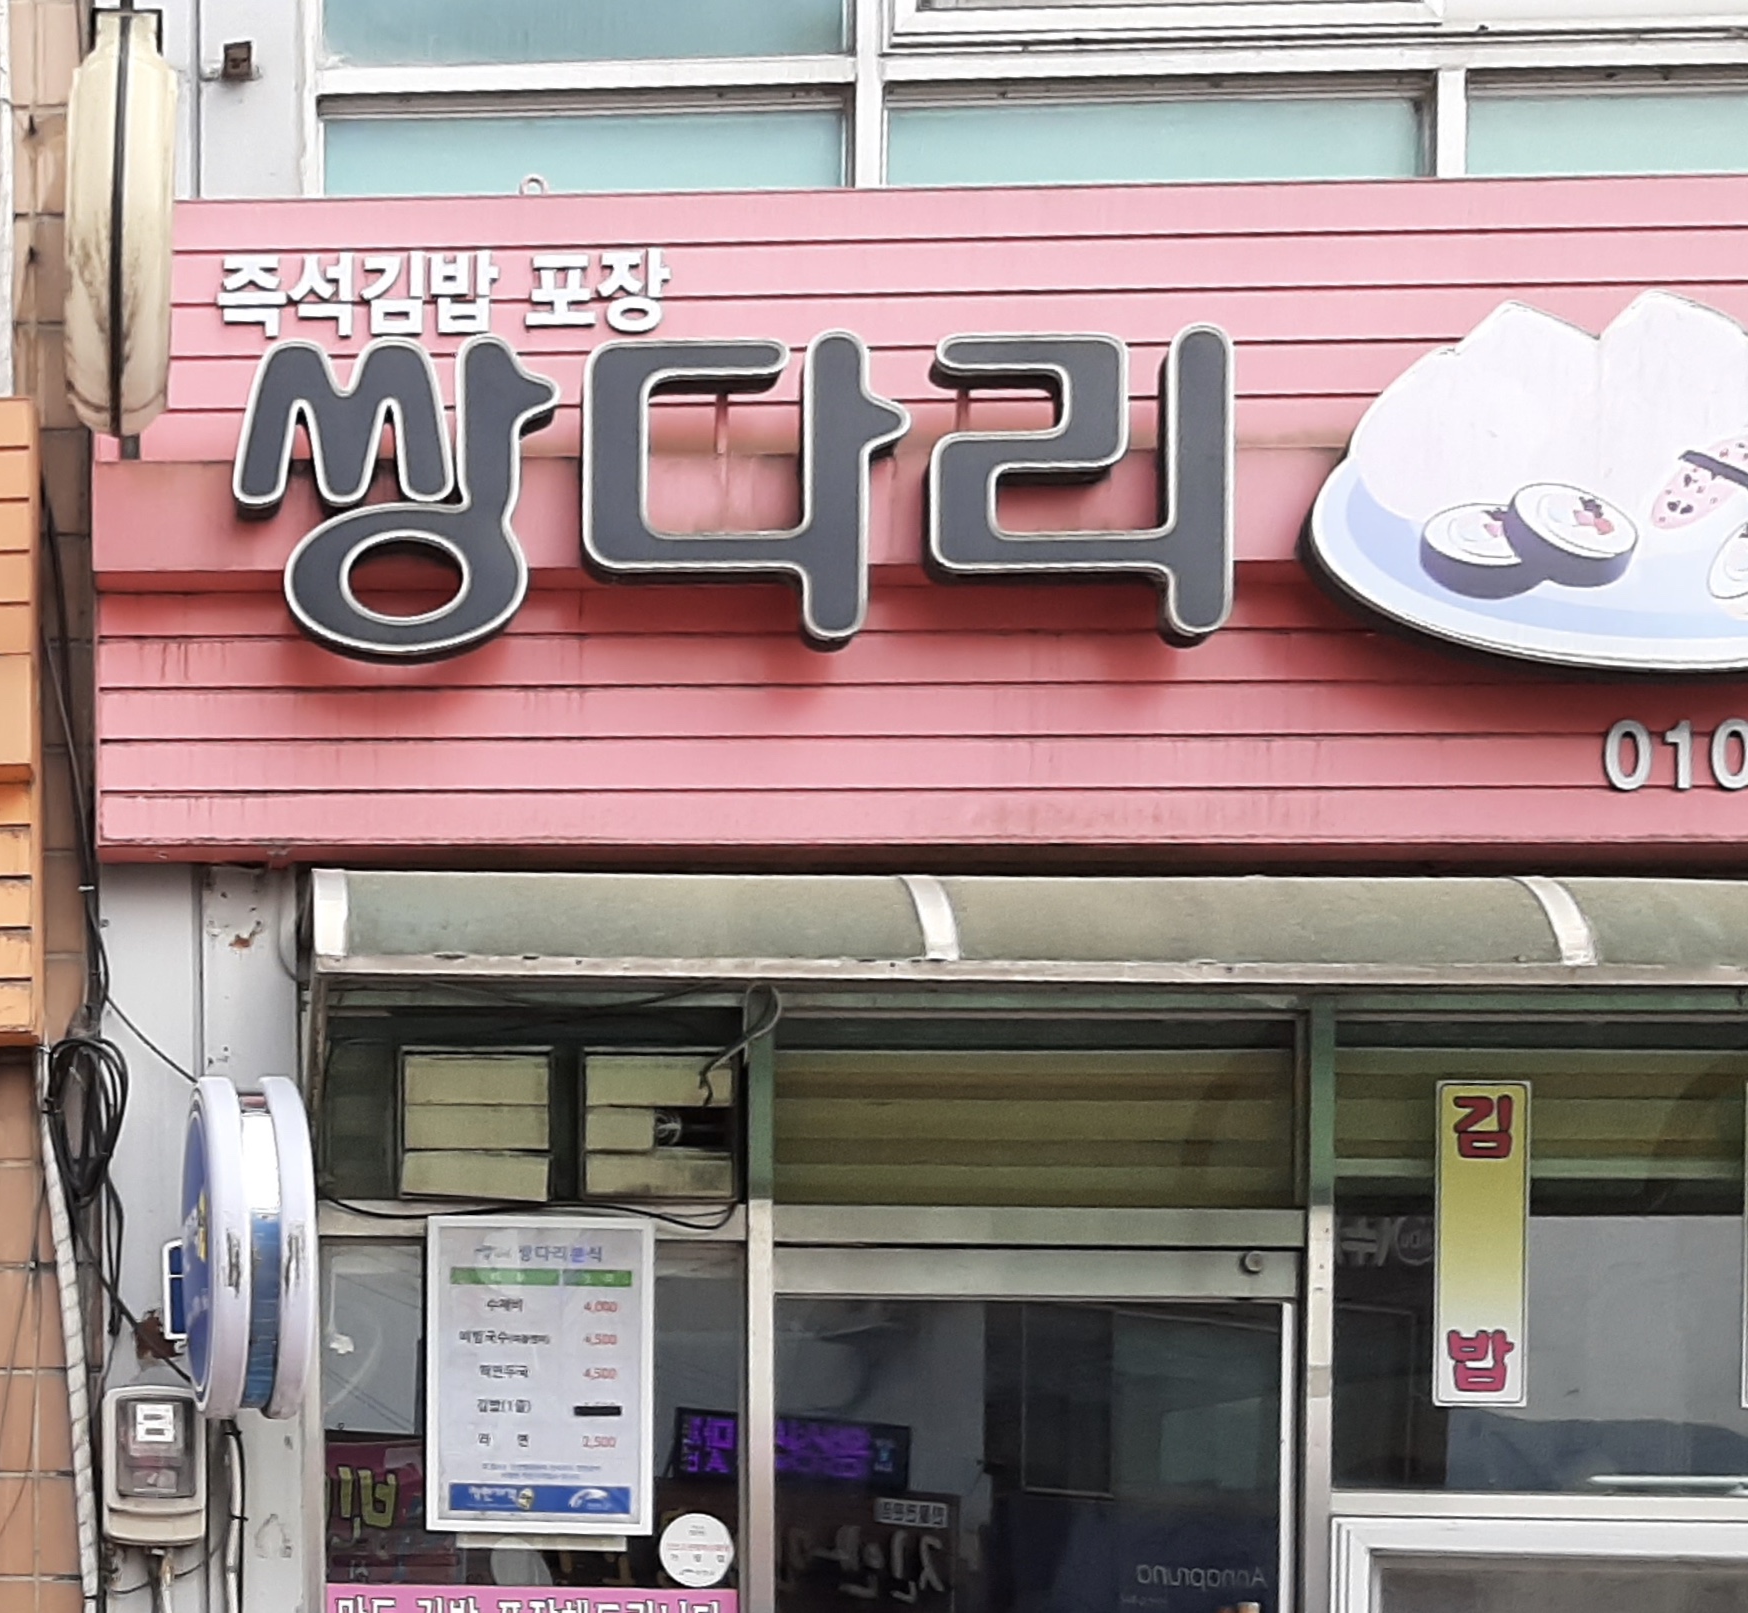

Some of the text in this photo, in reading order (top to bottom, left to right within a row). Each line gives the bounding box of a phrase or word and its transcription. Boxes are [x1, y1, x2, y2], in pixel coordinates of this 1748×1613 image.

[216, 247, 670, 337] 즉석김밥 포장
[232, 324, 1236, 665] 쌍다리
